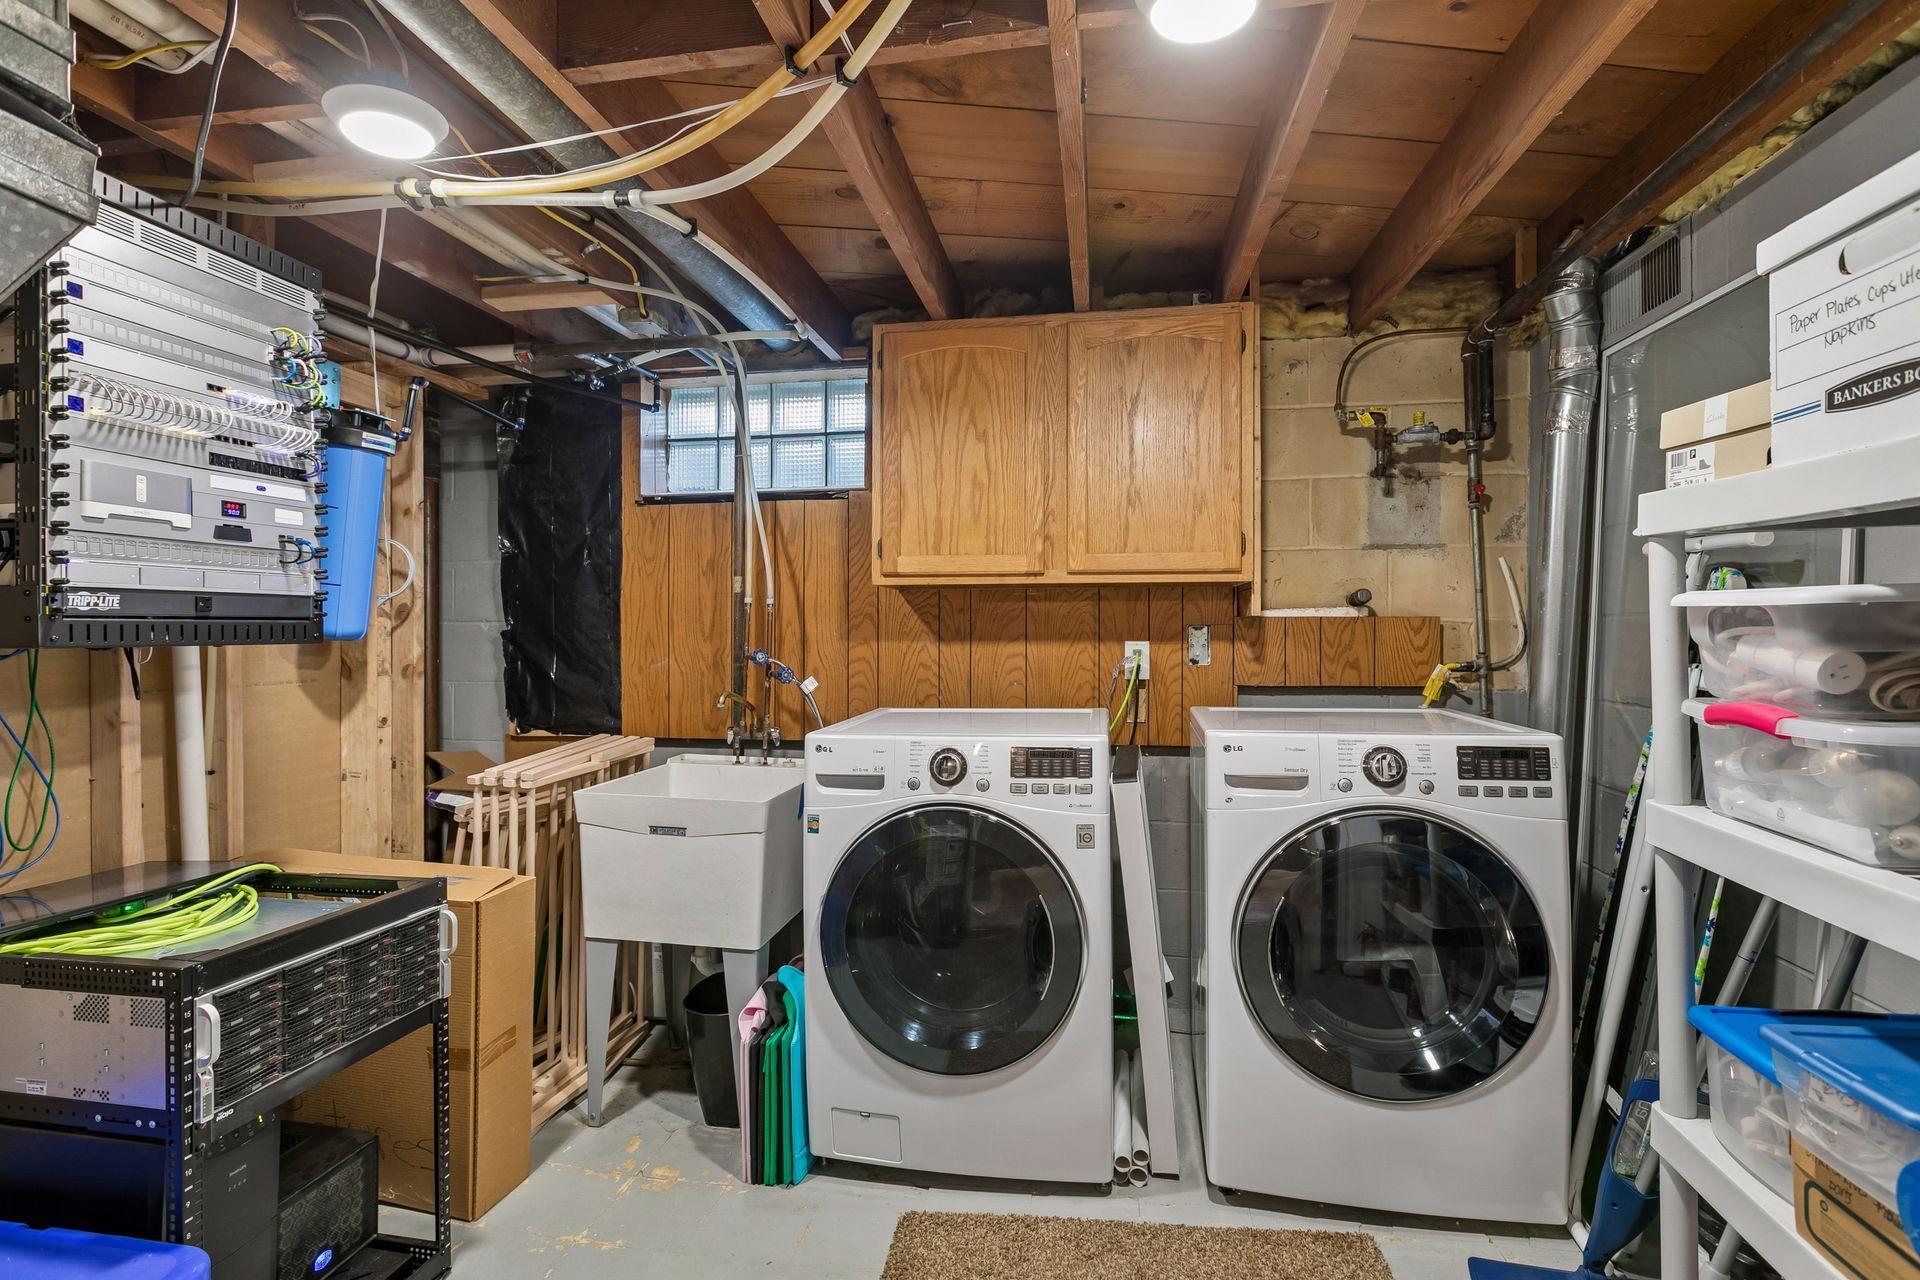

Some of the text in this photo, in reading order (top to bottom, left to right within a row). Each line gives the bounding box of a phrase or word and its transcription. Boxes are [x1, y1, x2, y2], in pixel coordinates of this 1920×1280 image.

[1789, 307, 1821, 333] Paper
[1826, 294, 1860, 318] Plates
[1867, 280, 1896, 303] Cups
[1833, 372, 1902, 405] BANKERS
[184, 1010, 191, 1018] 15
[184, 1042, 191, 1050] 14
[185, 1168, 192, 1176] 10
